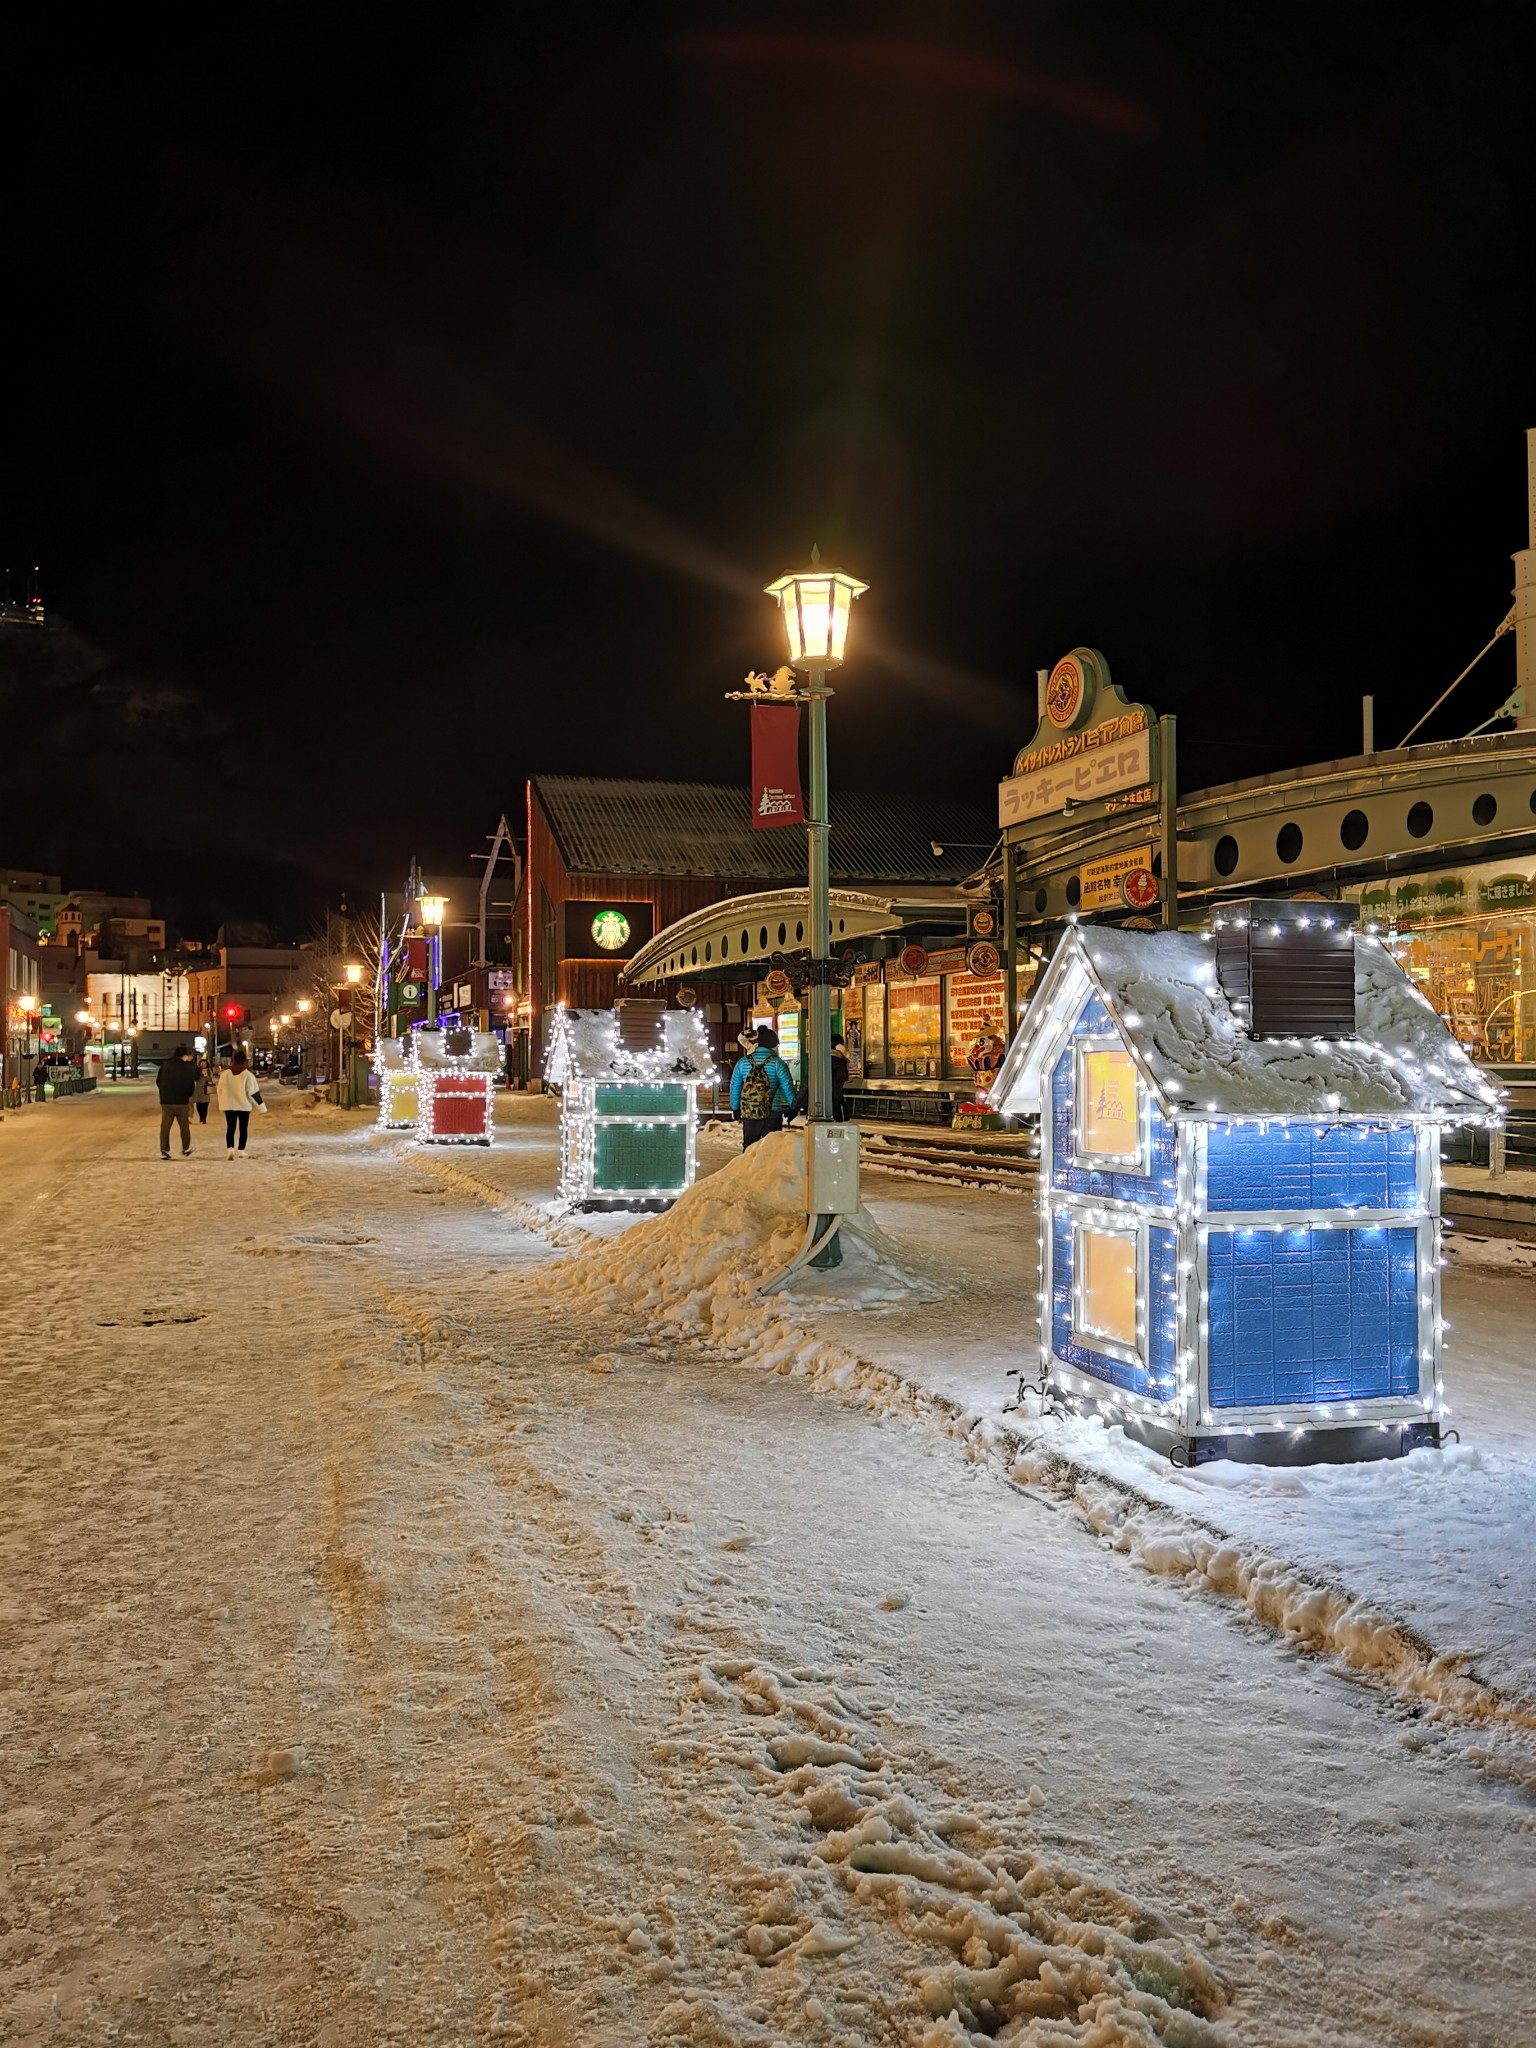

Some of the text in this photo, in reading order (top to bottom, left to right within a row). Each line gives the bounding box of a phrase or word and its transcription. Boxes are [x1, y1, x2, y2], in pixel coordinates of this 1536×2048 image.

[1004, 747, 1141, 814] ラッキーピエロ
[1084, 878, 1111, 894] 函館名物
